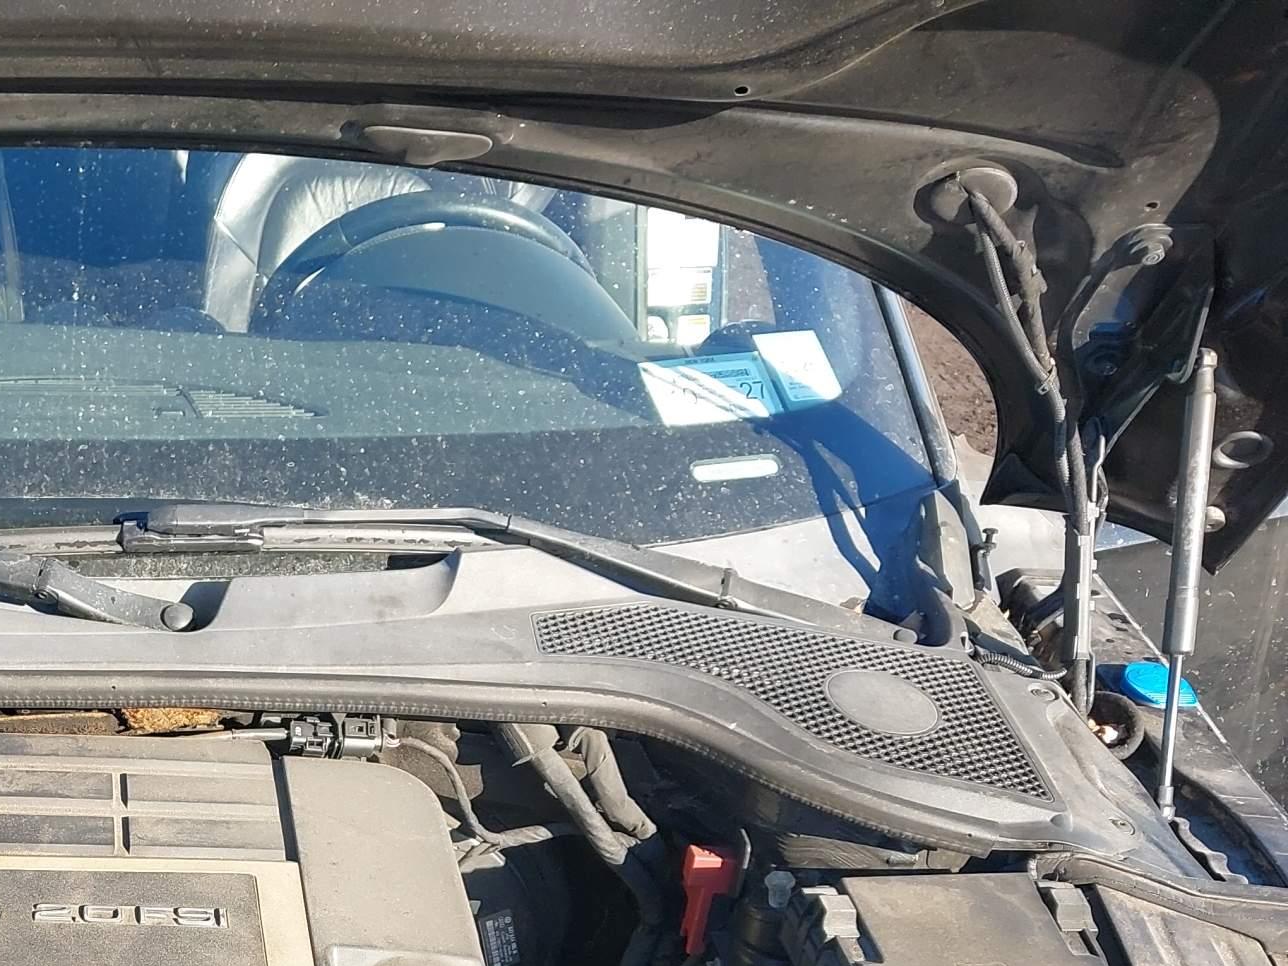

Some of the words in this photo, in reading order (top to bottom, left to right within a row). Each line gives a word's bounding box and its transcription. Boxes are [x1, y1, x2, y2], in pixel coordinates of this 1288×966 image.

[739, 380, 765, 399] 27
[32, 903, 120, 923] 2.0
[135, 905, 230, 928] FSI
